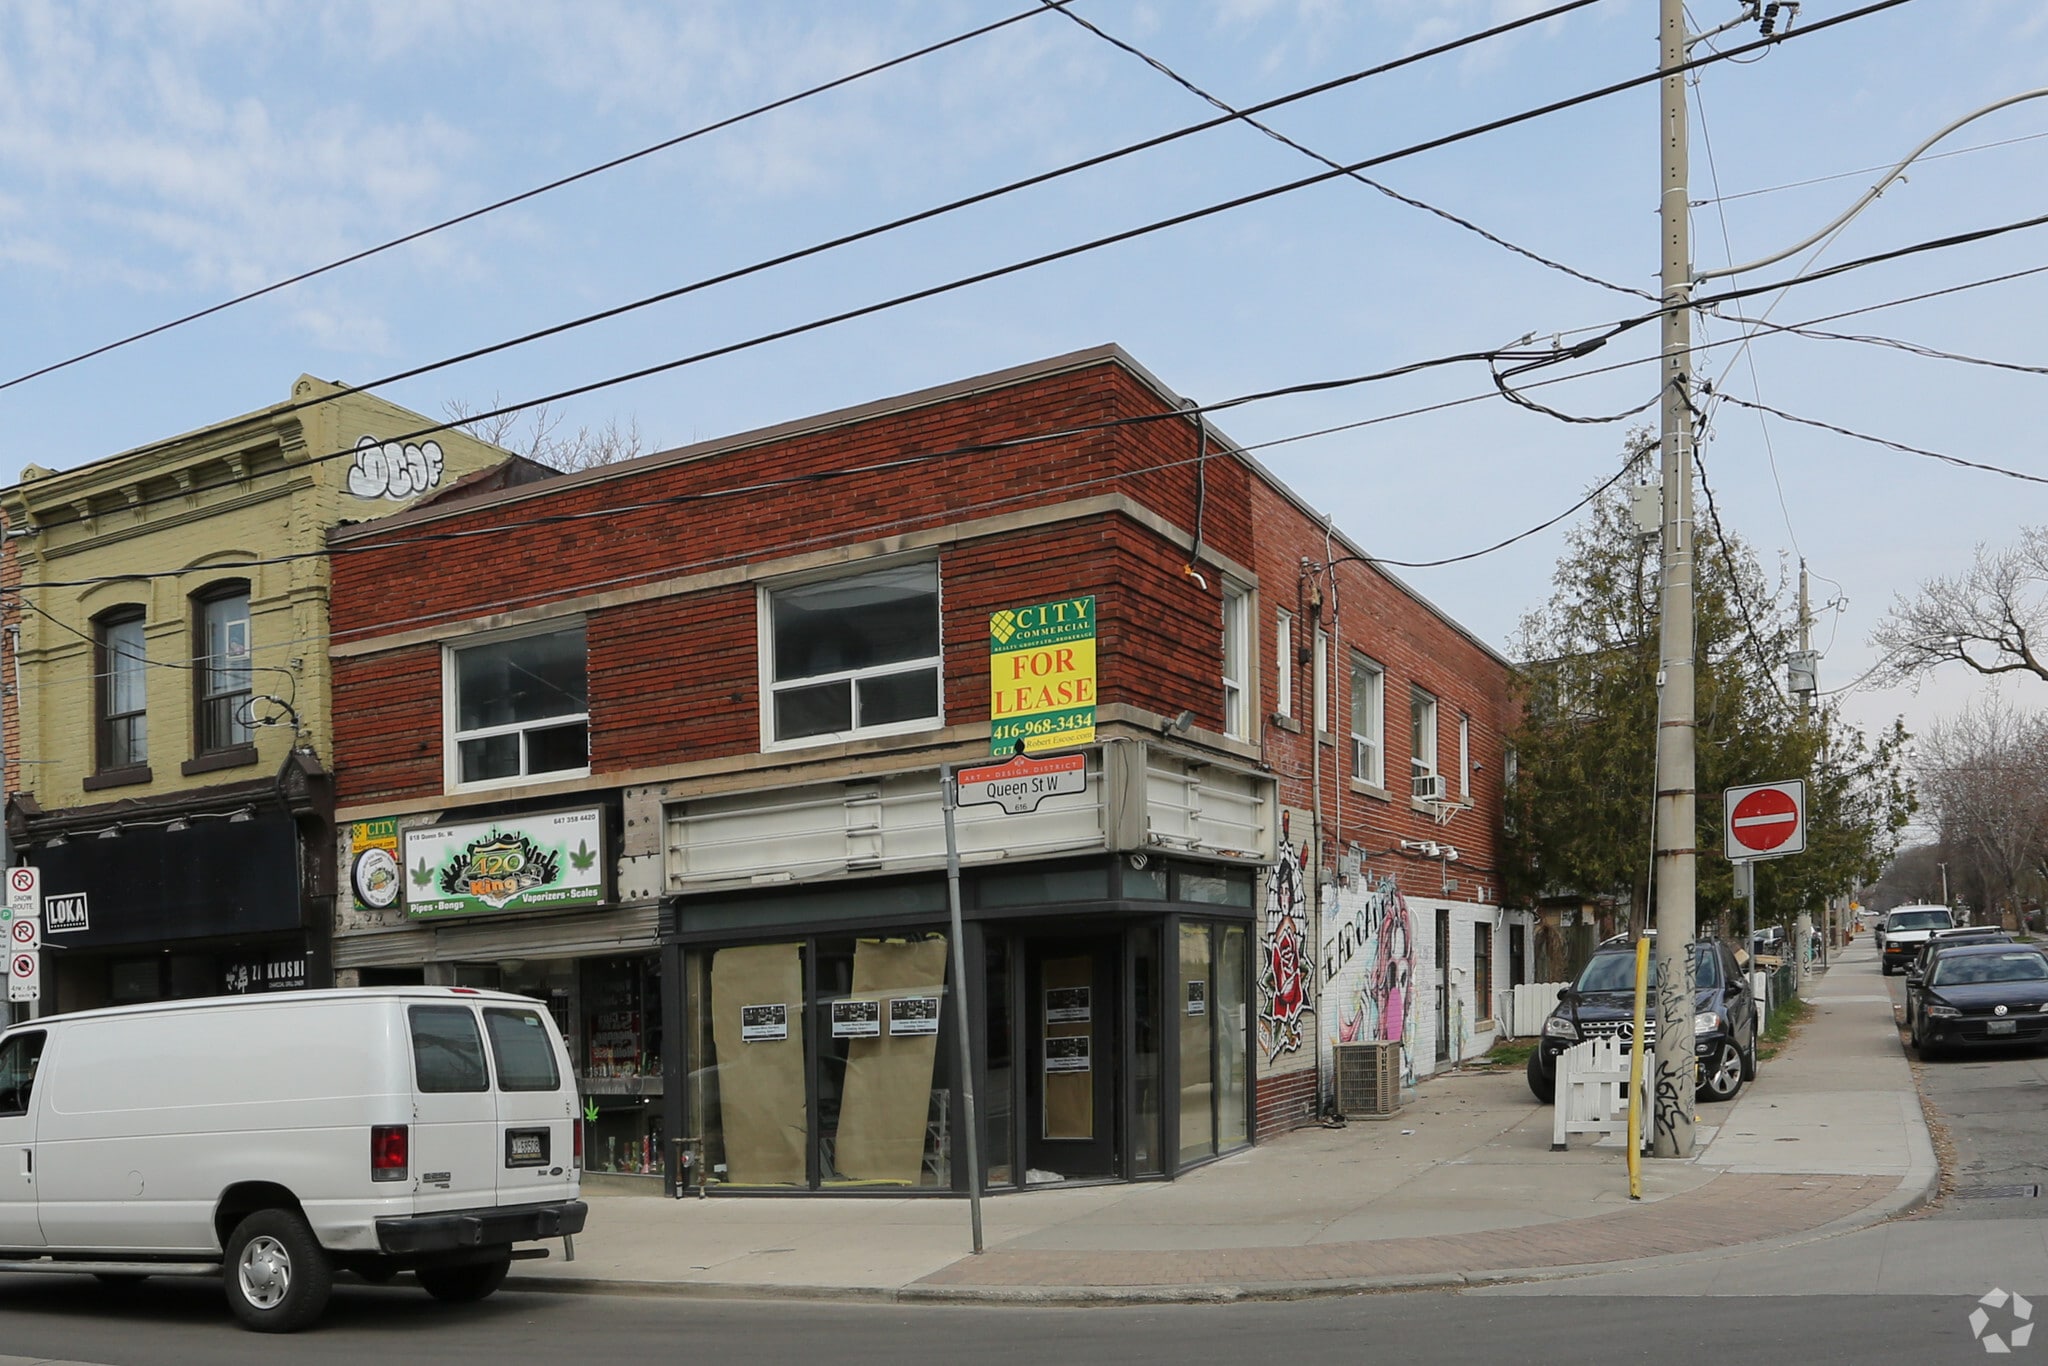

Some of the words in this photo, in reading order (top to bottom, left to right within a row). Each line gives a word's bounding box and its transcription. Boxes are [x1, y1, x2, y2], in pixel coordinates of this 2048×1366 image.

[1016, 599, 1090, 629] CITY
[1016, 621, 1090, 640] COMMERCIAL
[1011, 648, 1075, 680] FOR
[994, 677, 1093, 714] LEASE
[993, 712, 1092, 740] 416-968-3434
[993, 746, 1015, 756] CIT
[1026, 738, 1051, 748] Robert
[995, 768, 1029, 778] DESIGN
[1033, 762, 1077, 773] DISTRICT
[987, 782, 1028, 798] Queen
[1032, 777, 1043, 793] St
[1047, 775, 1058, 791] W
[1015, 803, 1027, 811] 616
[580, 813, 596, 821] 4420
[367, 821, 395, 836] CITY
[470, 853, 525, 877] 420
[522, 890, 566, 903] Vaporizers
[571, 887, 598, 899] Scales
[49, 898, 85, 925] LOKA
[410, 902, 433, 914] Pipes
[438, 900, 464, 912] Bongs
